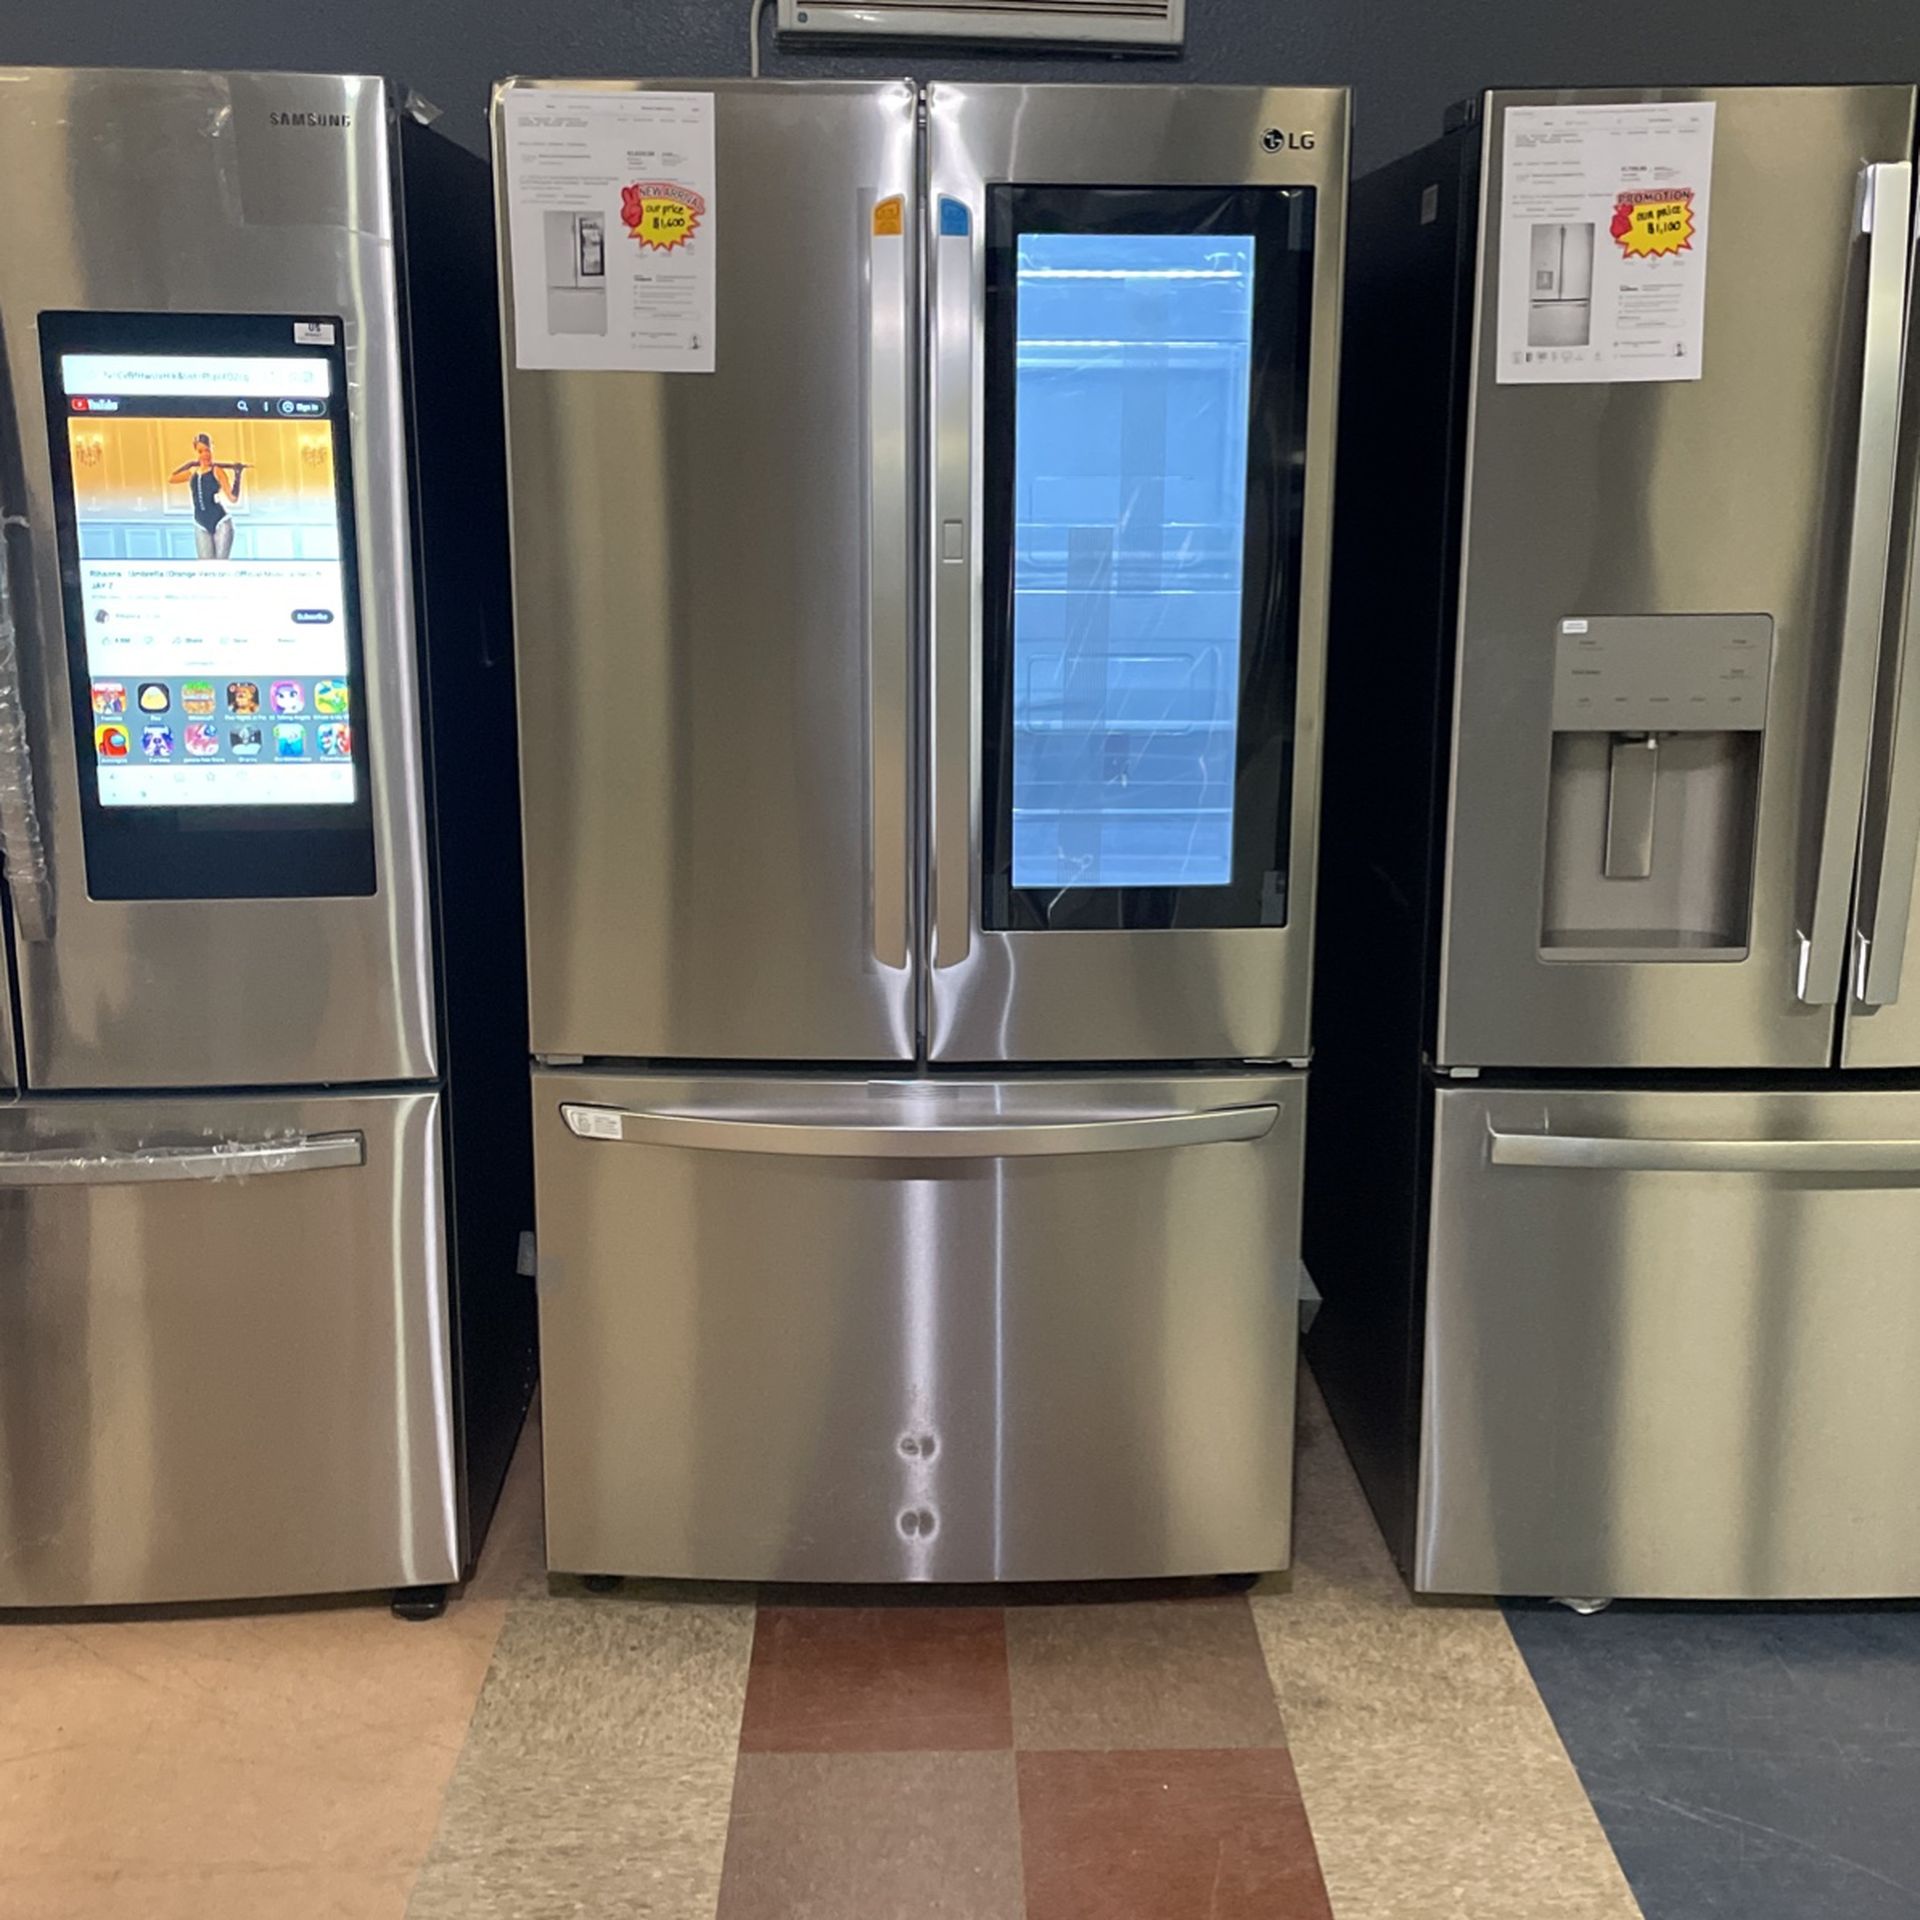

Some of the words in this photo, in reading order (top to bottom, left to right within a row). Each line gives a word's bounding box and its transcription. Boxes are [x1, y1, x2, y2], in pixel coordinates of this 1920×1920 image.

[270, 112, 351, 127] SAMSUNG
[1617, 190, 1690, 204] PROMOTION
[652, 217, 686, 230] $1,600
[1647, 221, 1681, 234] $1,100
